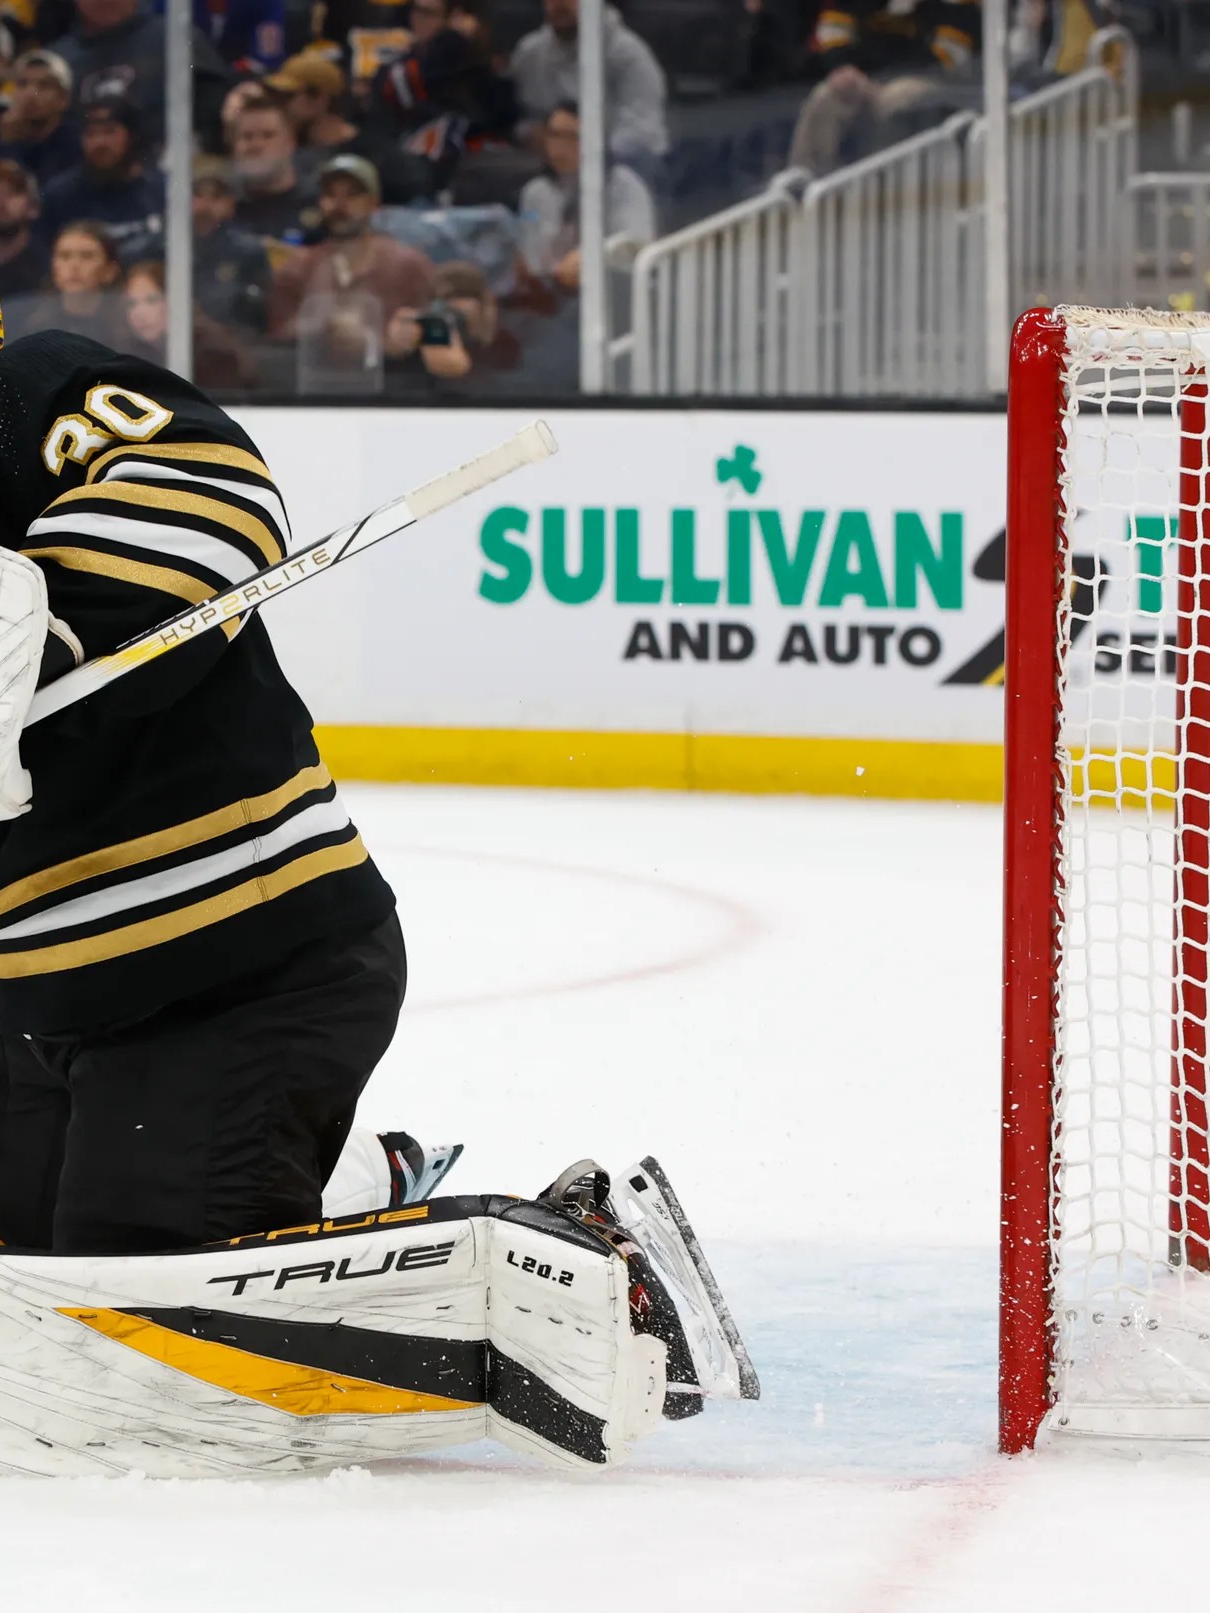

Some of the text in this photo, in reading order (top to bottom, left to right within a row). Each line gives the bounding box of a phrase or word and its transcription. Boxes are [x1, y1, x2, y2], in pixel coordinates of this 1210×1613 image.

[40, 384, 175, 477] 30
[478, 506, 964, 610] SULLIVAN
[622, 620, 755, 663] AND
[777, 623, 943, 667] AUTO
[201, 1205, 429, 1246] TRUE
[205, 1241, 457, 1297] TRUE
[506, 1249, 575, 1288] L20.2
